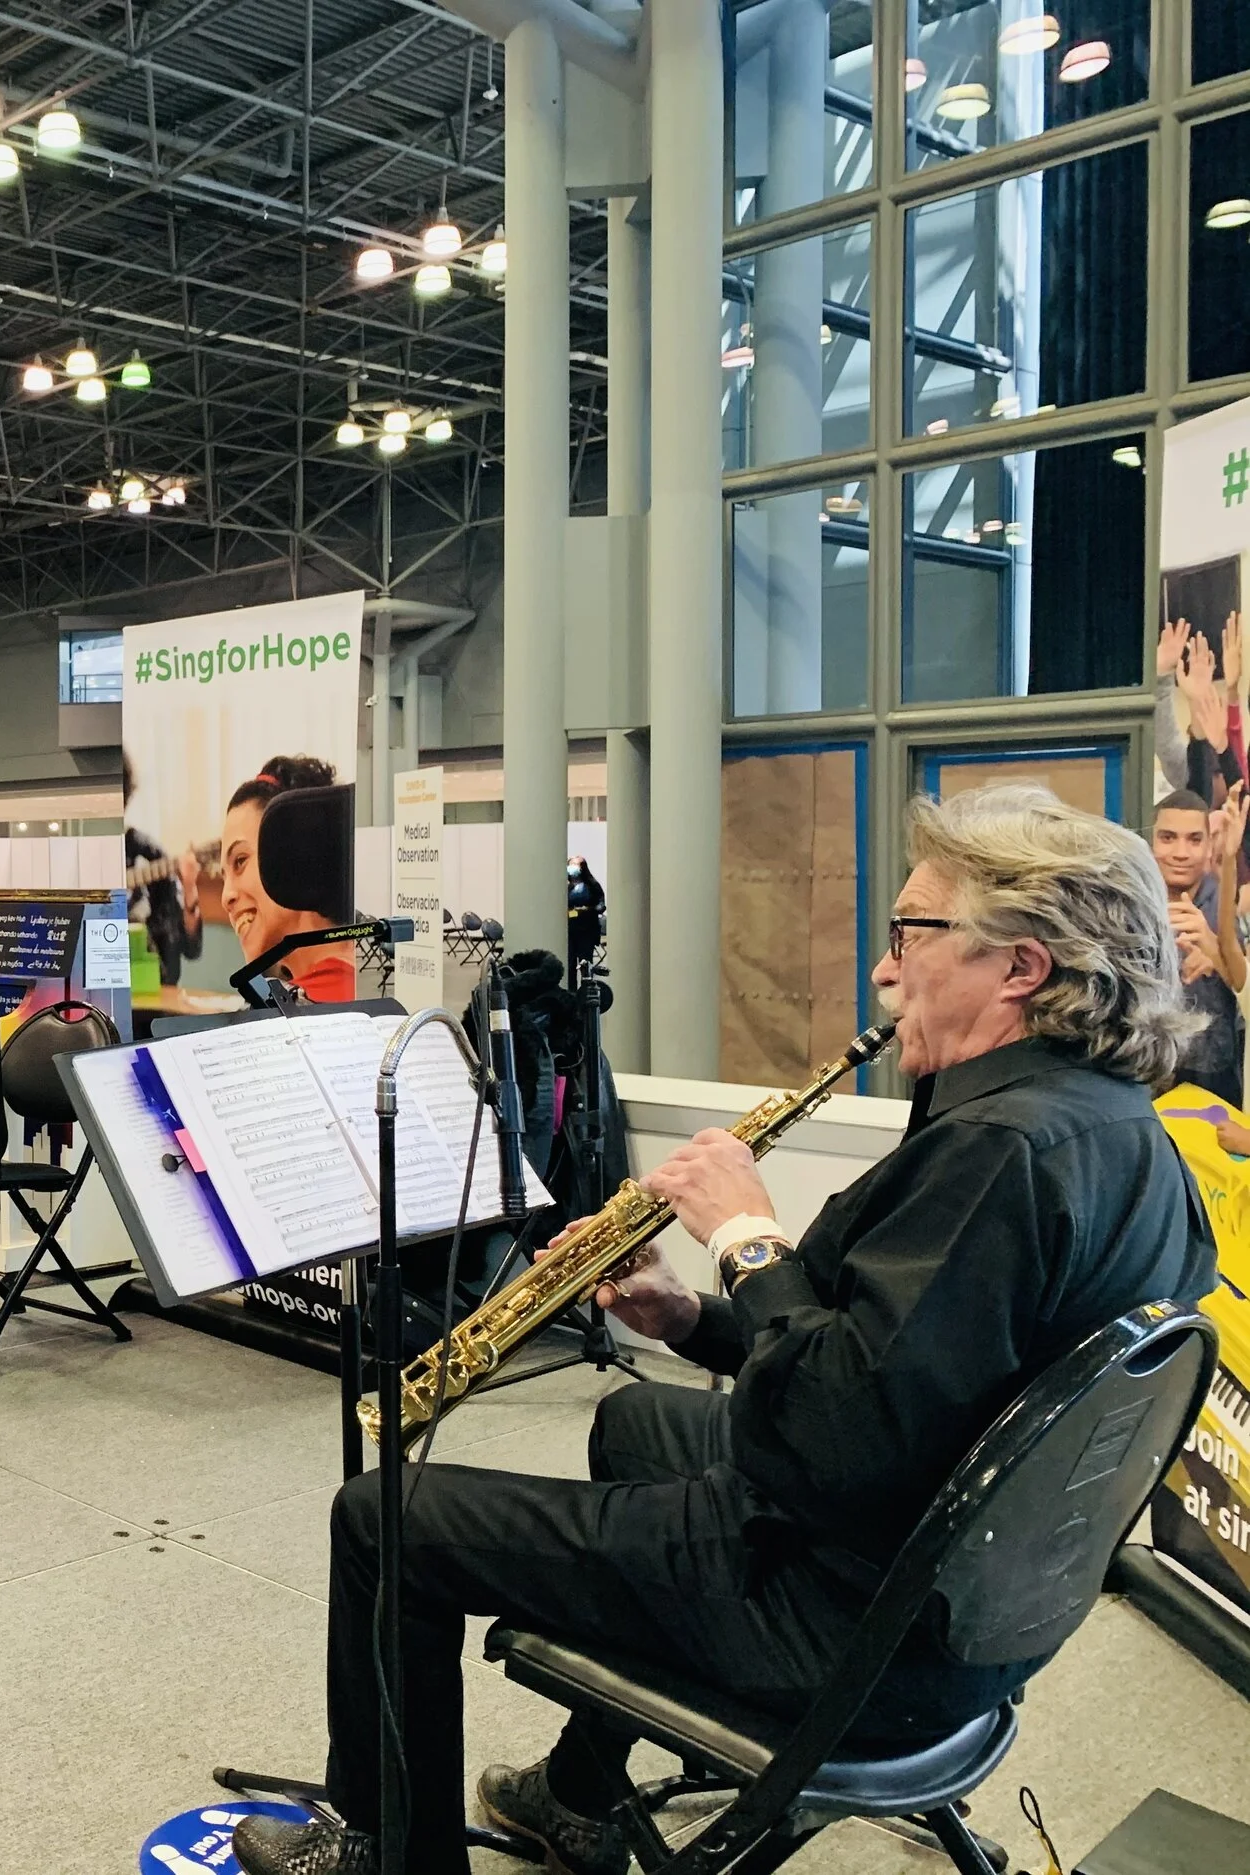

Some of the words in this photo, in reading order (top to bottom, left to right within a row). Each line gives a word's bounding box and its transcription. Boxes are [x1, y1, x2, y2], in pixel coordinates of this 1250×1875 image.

[136, 632, 351, 684] #SingforHope
[404, 823, 431, 840] Medical
[397, 847, 439, 863] Observation
[397, 893, 440, 911] Observación
[413, 916, 430, 933] dica
[1184, 1484, 1210, 1527] at
[203, 1841, 234, 1867] ank
